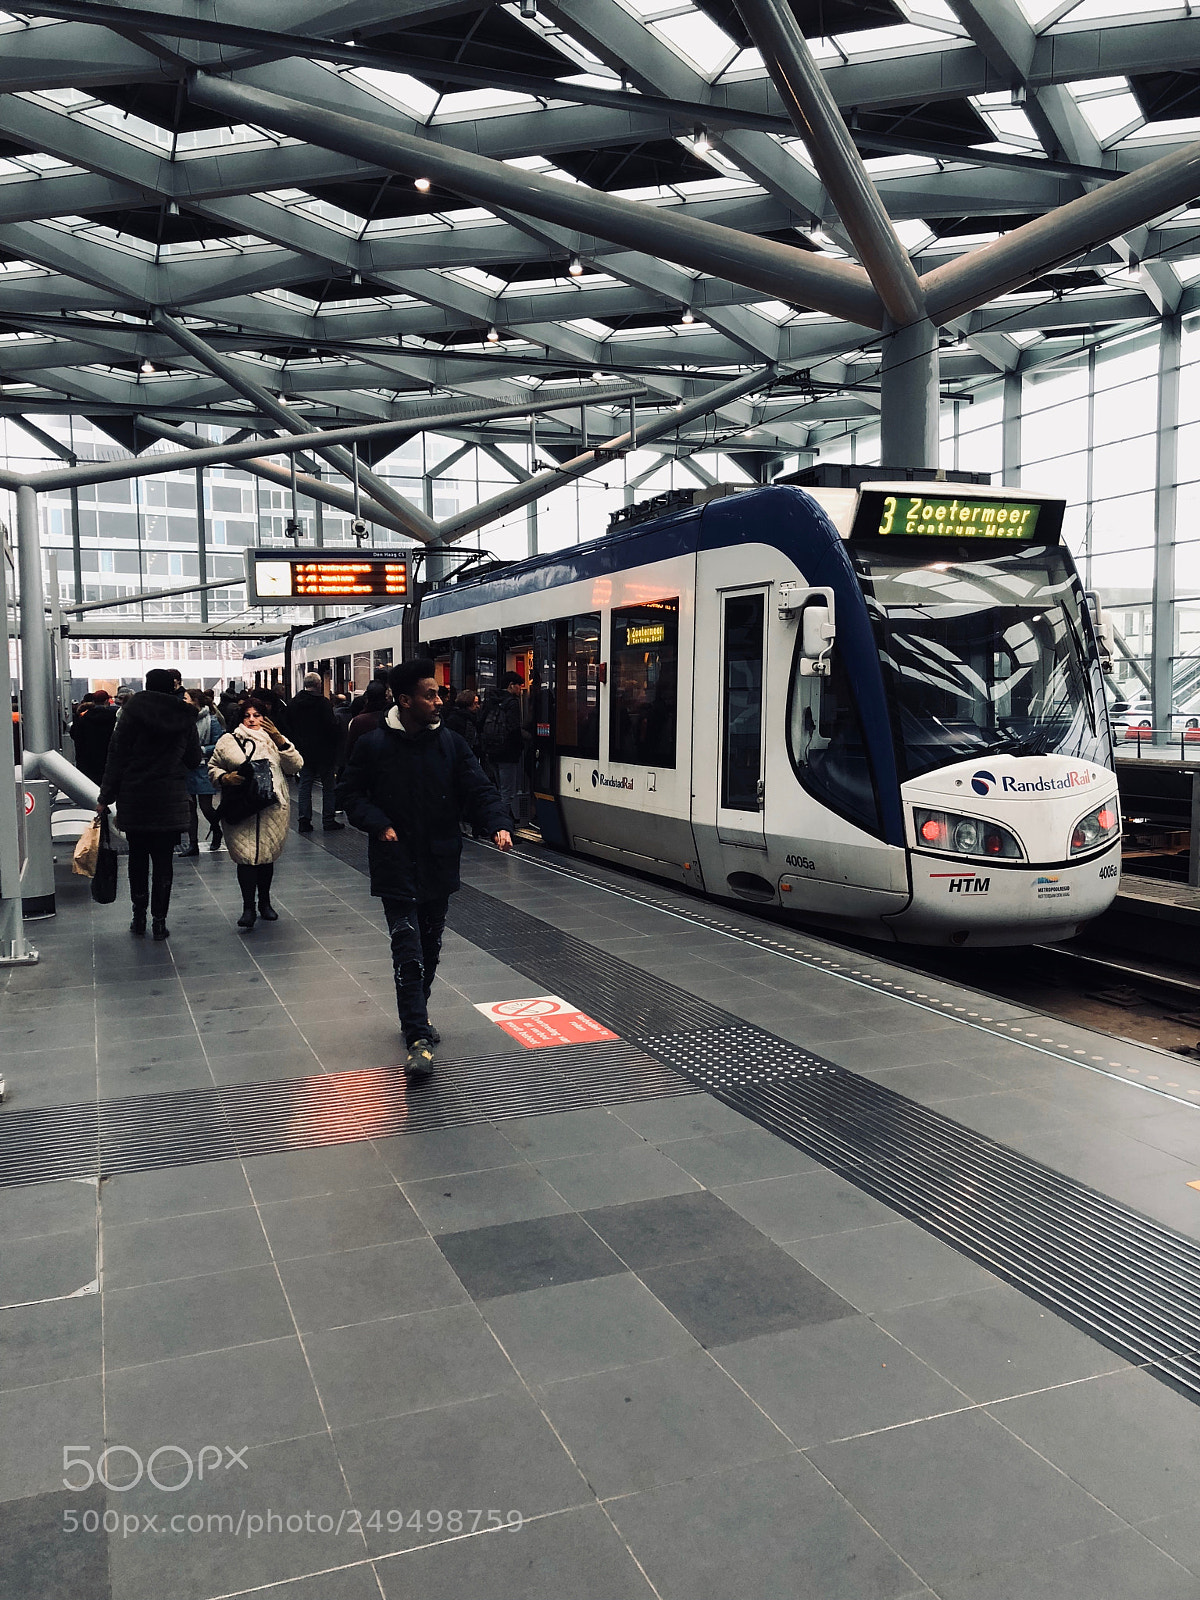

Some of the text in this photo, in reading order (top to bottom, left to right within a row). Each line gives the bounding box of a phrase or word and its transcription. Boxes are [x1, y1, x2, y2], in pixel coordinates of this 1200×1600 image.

[878, 496, 1031, 535] 3 Zoetermeer
[905, 520, 1023, 538] Centrum-West
[631, 626, 663, 638] Zoetermeer
[600, 773, 634, 791] RandstadRail
[1002, 769, 1091, 792] RandstadRail
[785, 854, 816, 871] 4005a
[1098, 864, 1118, 880] 4005a
[948, 877, 991, 893] HTM
